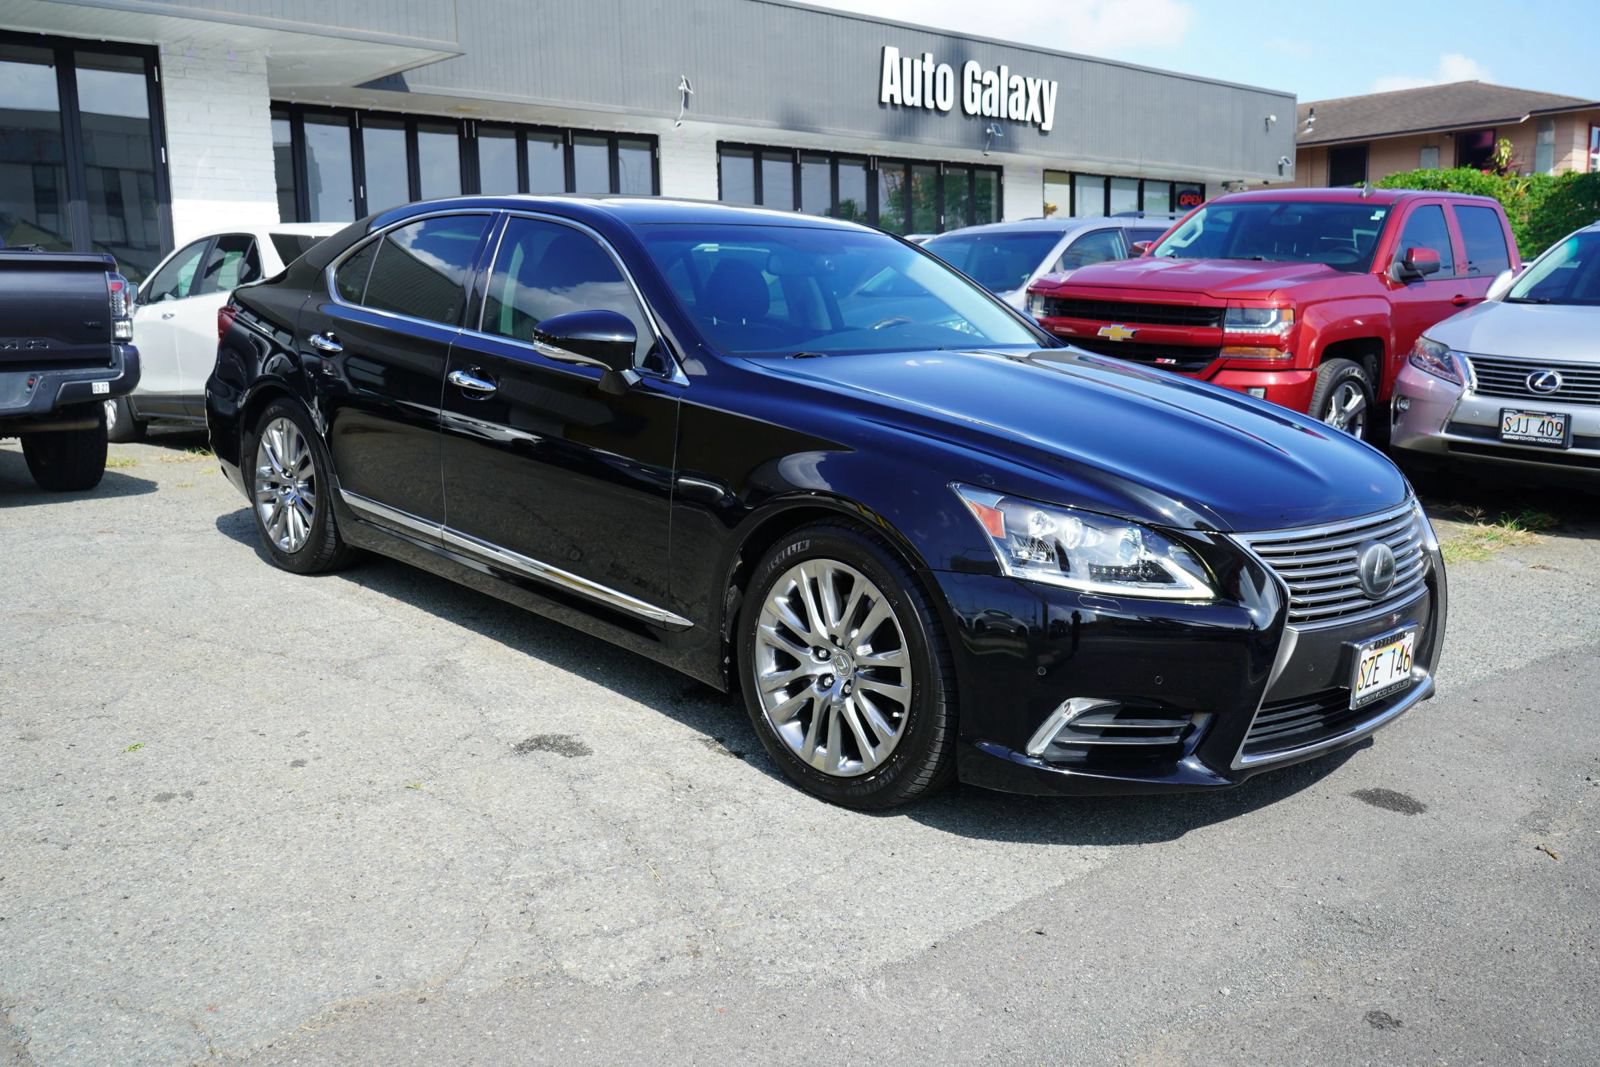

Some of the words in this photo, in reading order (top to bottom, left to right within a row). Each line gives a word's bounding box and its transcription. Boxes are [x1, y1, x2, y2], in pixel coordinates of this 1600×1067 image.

[880, 46, 954, 111] Auto
[962, 60, 1058, 131] Galaxy
[1180, 194, 1202, 206] OPEN
[1504, 417, 1529, 433] SJJ
[1537, 420, 1563, 437] 409
[1358, 653, 1383, 691] SZE
[1390, 643, 1411, 679] 146
